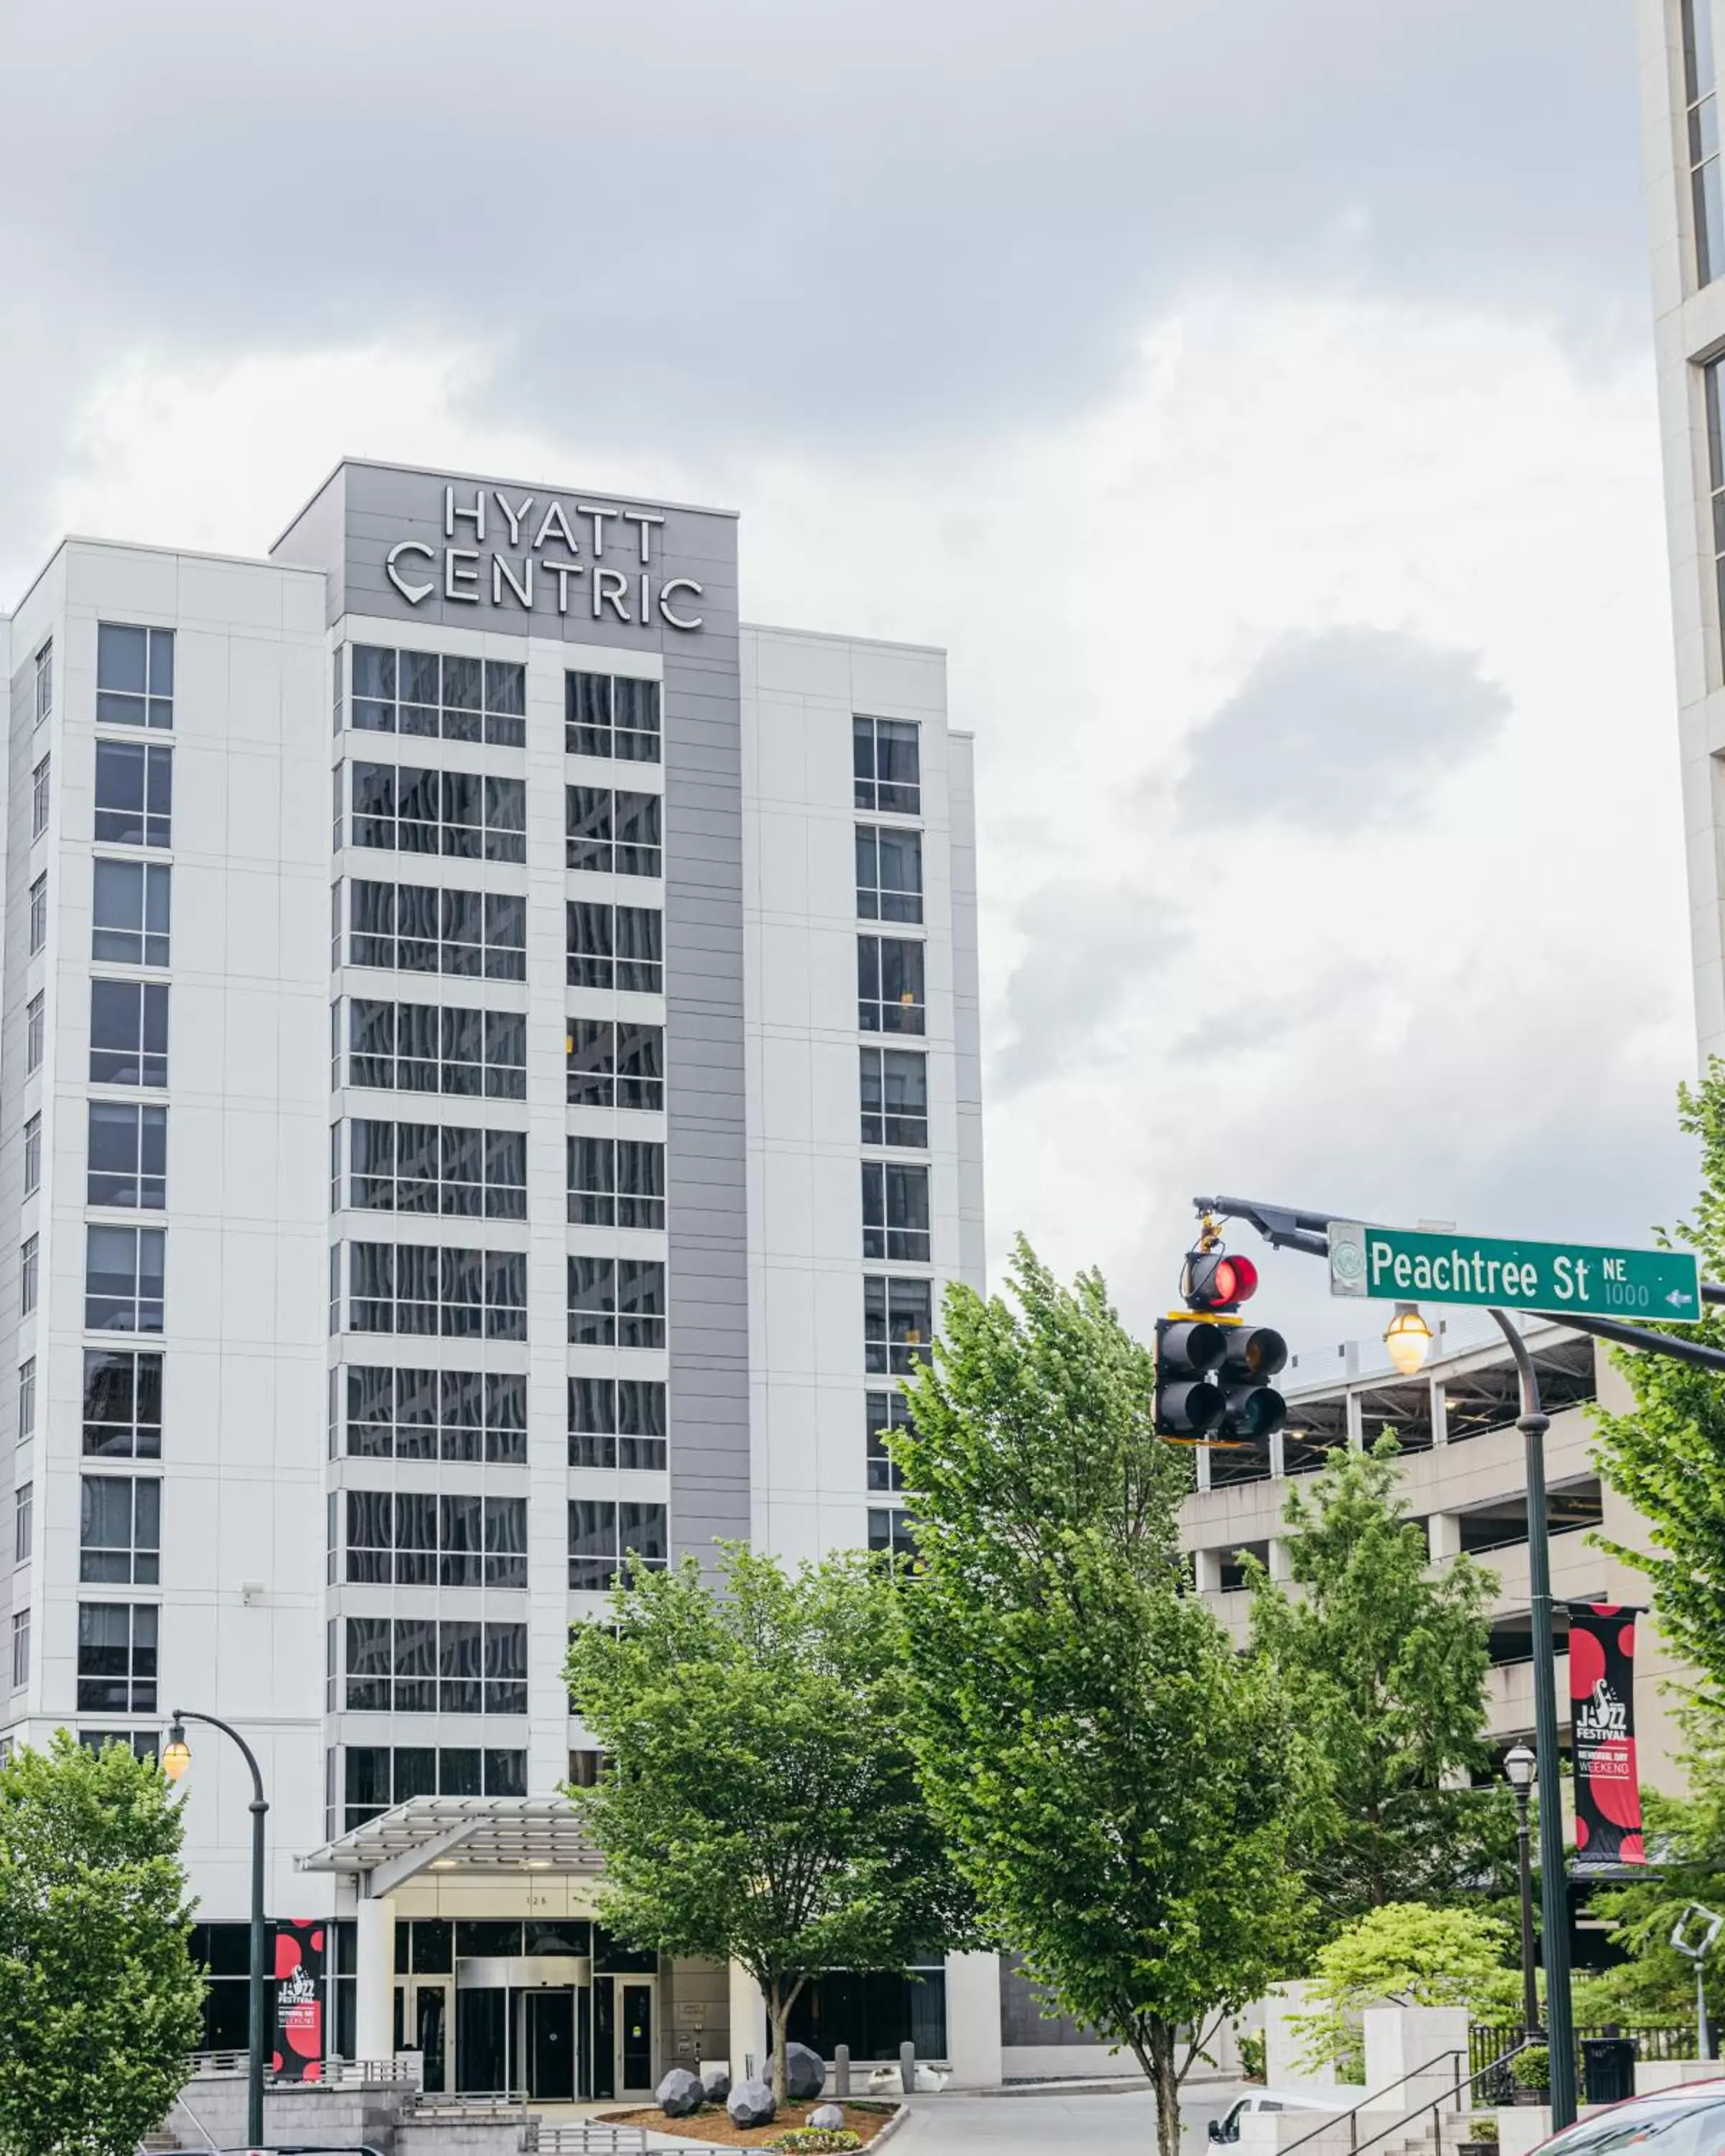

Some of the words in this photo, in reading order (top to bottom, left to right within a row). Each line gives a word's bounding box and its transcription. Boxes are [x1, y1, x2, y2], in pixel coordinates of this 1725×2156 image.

[445, 485, 665, 563] HYATT
[386, 541, 702, 629] CENTRIC
[1371, 1242, 1538, 1298] Peachtree
[1552, 1256, 1589, 1302] St
[1603, 1258, 1627, 1282] NE
[1605, 1283, 1650, 1307] 1000
[1576, 1704, 1627, 1729] JAZZ
[1576, 1728, 1628, 1741] FESTIVAL
[1579, 1761, 1629, 1774] WEEKEND
[278, 1980, 315, 1996] JAZZ
